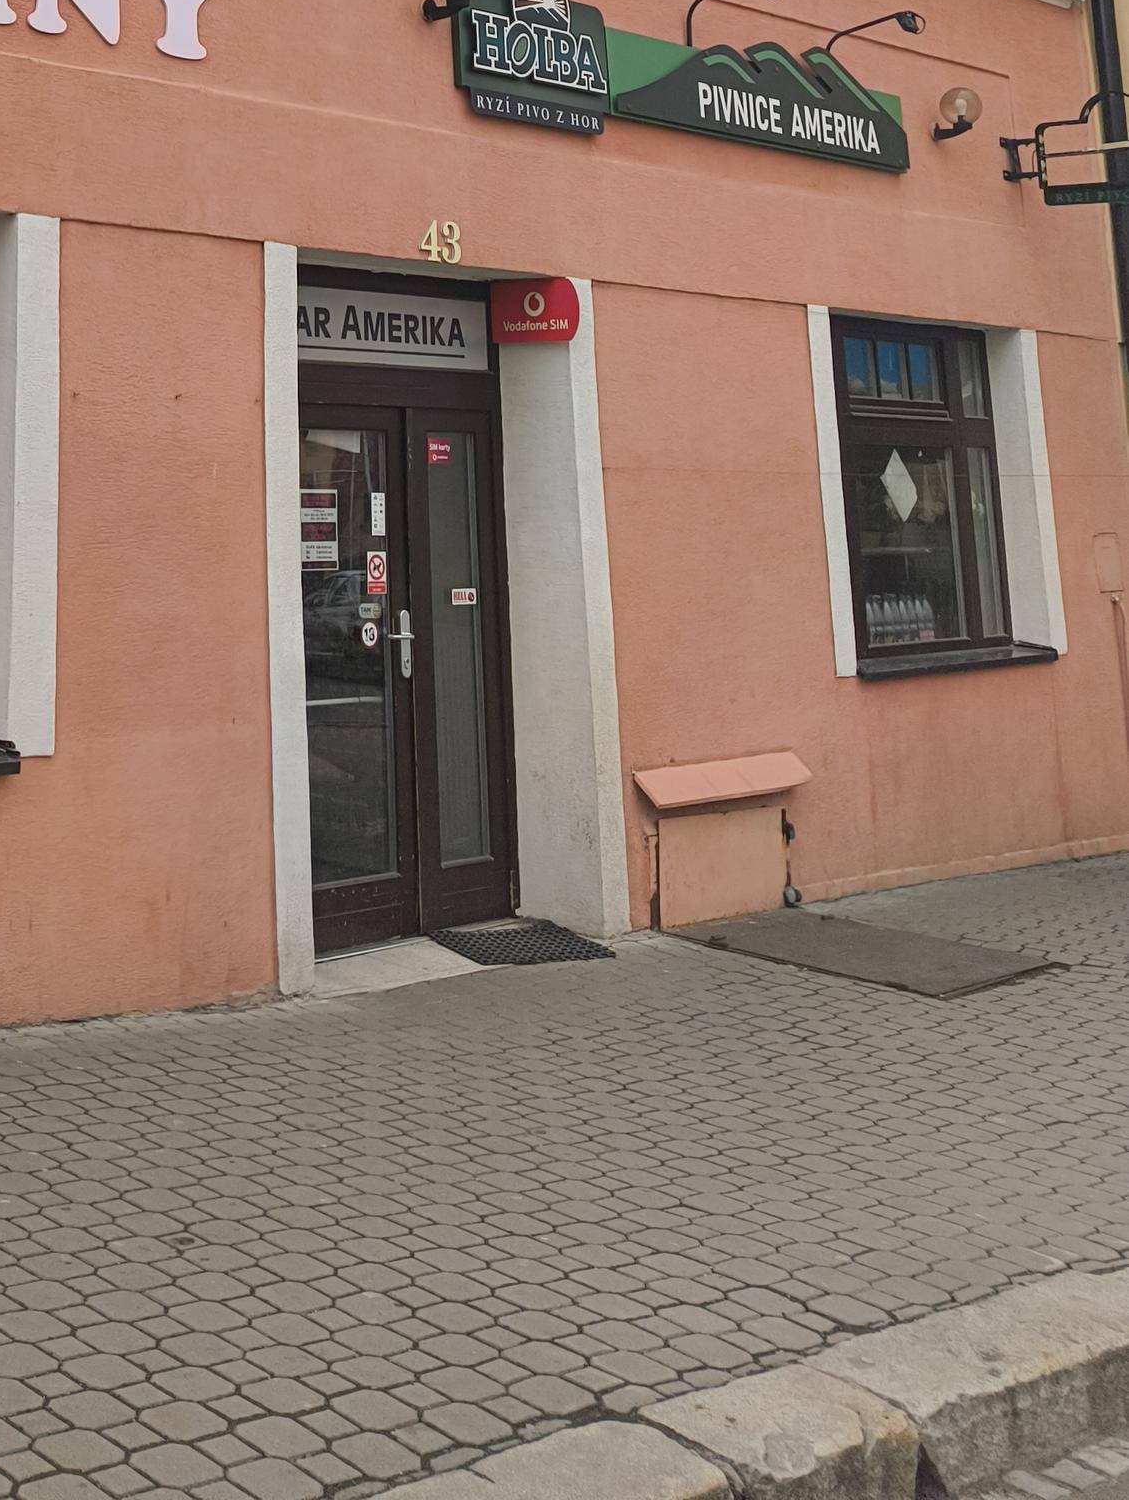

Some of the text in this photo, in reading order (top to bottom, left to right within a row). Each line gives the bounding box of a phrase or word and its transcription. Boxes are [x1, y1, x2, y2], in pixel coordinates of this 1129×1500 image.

[471, 9, 608, 94] HOLBA
[476, 95, 600, 130] RYZÍ PIVO Z HOR
[697, 81, 881, 155] PIVNICE AMERIKA
[419, 219, 463, 264] 43
[341, 304, 466, 348] AMERIKA
[503, 319, 569, 332] Vodafone SIM
